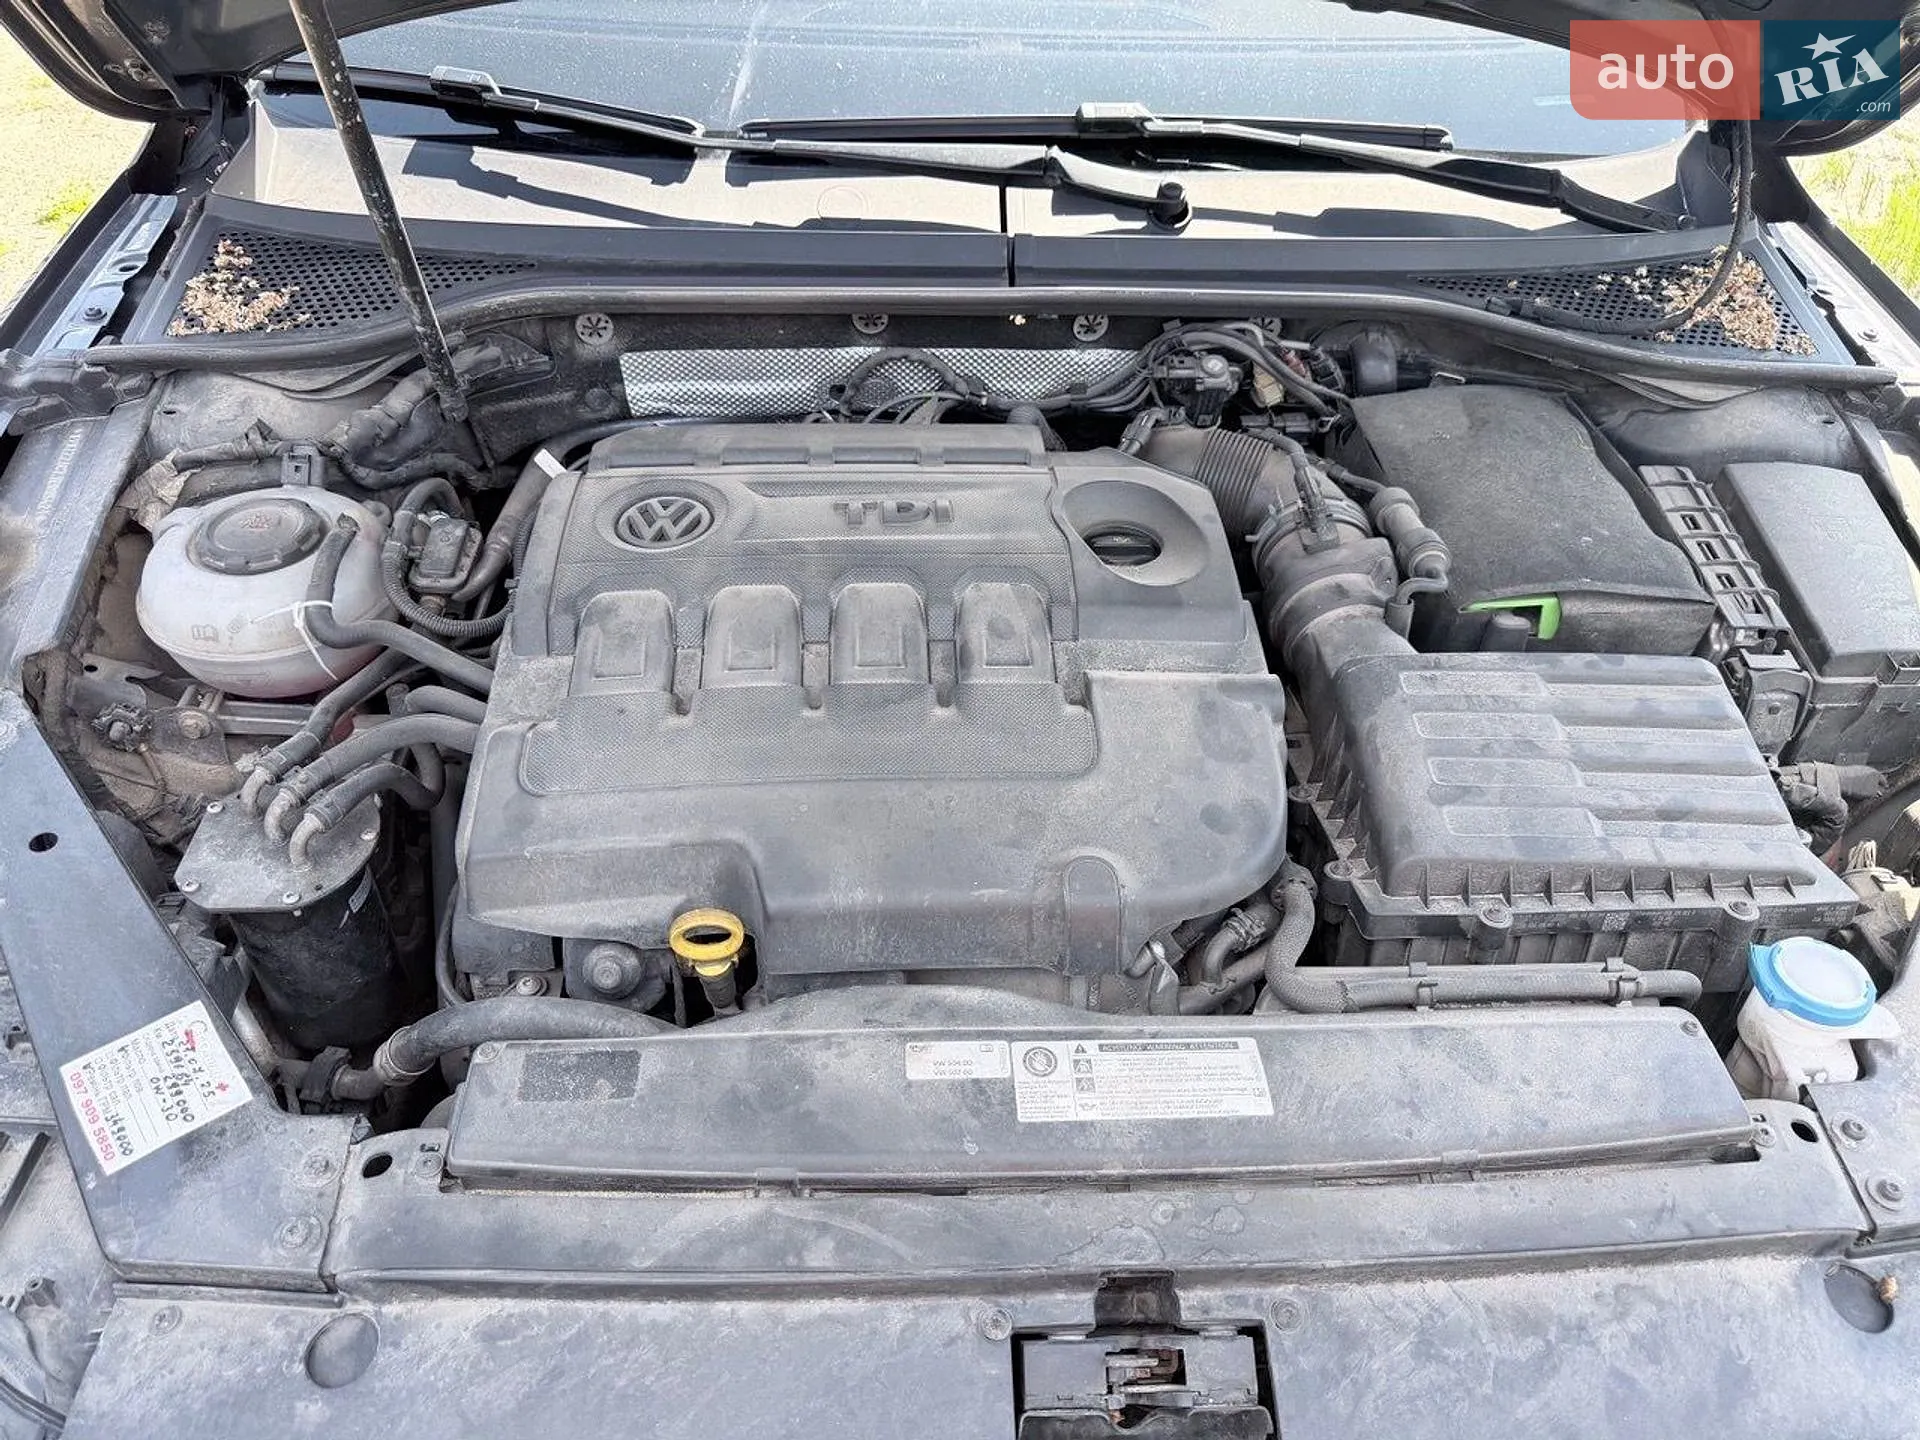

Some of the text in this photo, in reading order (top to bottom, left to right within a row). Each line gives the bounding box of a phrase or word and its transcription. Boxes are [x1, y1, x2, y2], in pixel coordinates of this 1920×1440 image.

[833, 501, 953, 528] TDI
[69, 1071, 115, 1161] 097 909 5850
